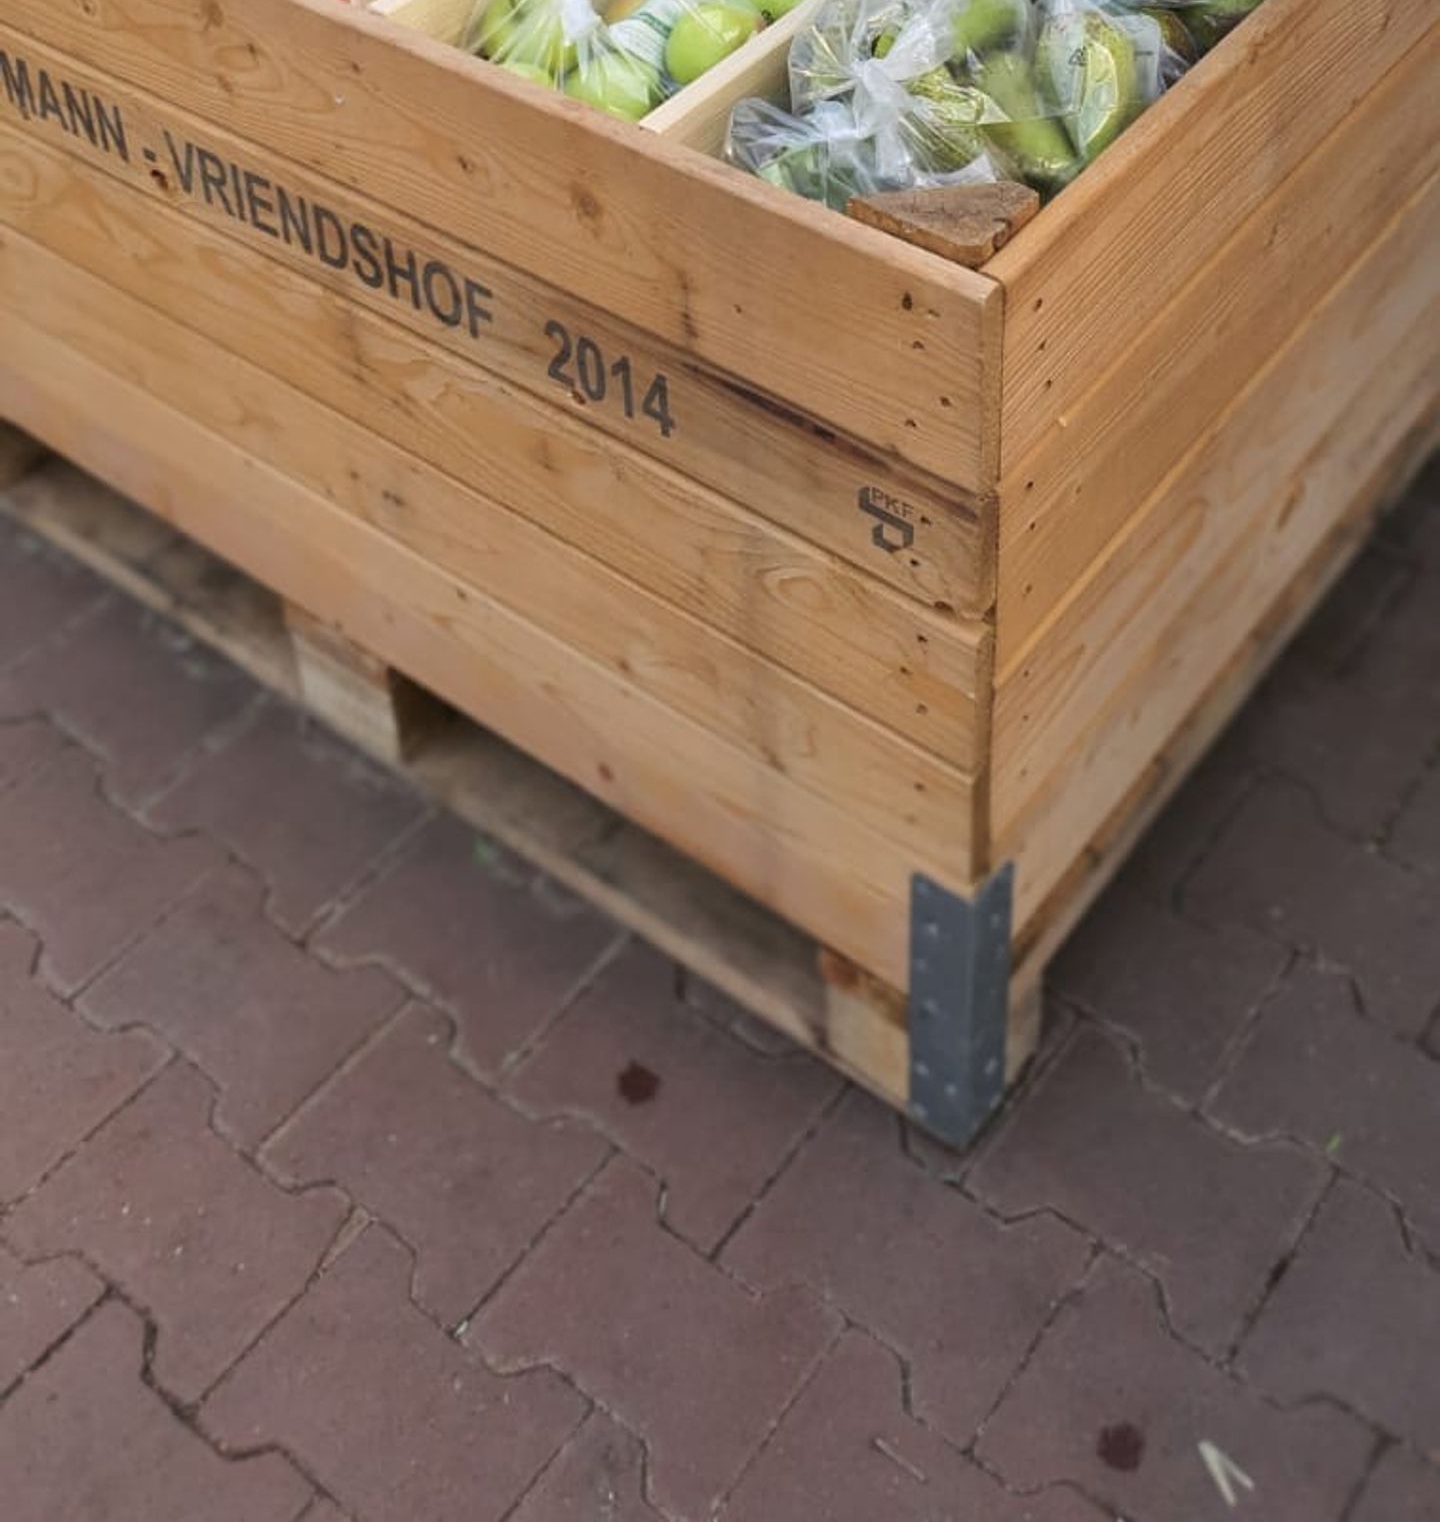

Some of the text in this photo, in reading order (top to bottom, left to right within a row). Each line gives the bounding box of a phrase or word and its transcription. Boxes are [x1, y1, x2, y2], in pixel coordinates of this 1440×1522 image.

[163, 129, 493, 339] VRIENDSHOF
[544, 319, 676, 439] 2014
[871, 486, 915, 519] PKF
